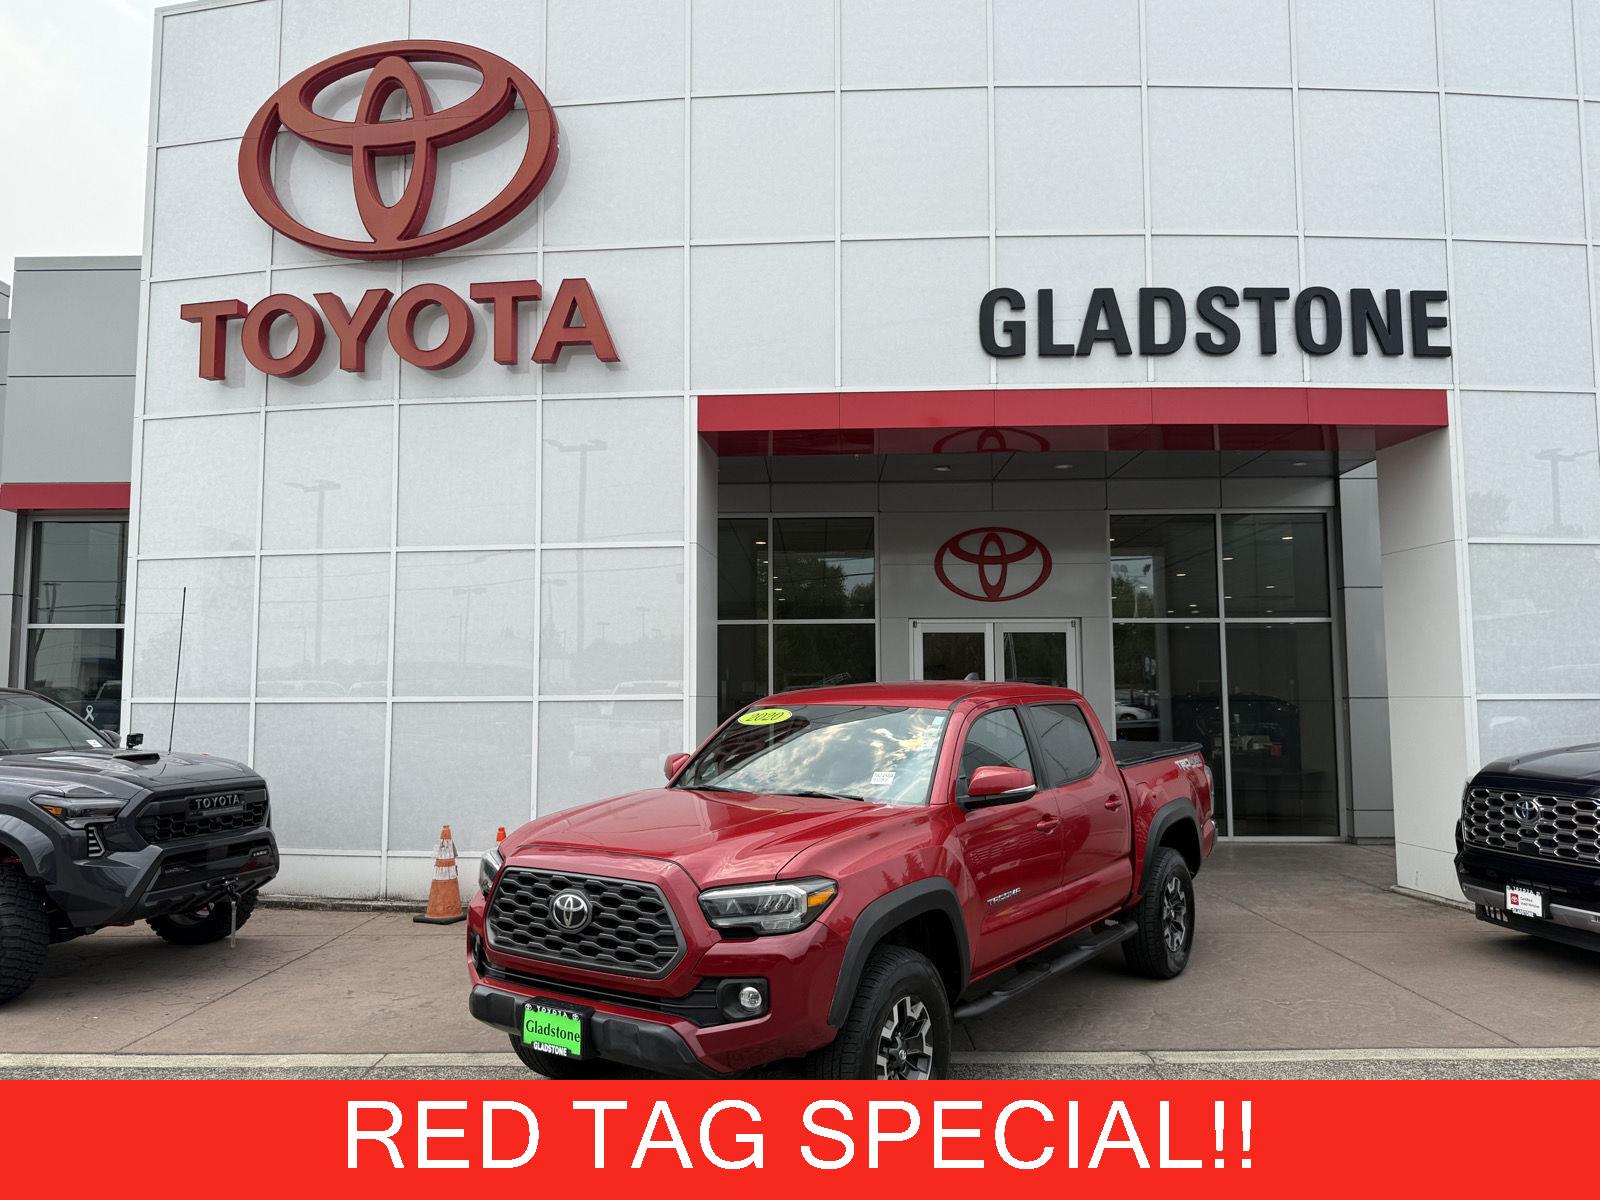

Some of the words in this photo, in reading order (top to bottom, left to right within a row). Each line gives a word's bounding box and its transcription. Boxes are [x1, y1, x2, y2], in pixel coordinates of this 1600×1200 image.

[181, 278, 620, 380] TOYOTA
[979, 286, 1452, 359] GLADSTONE
[744, 711, 785, 722] 2020
[195, 794, 241, 809] TOYOTA
[536, 1005, 567, 1017] TOYOTA
[526, 1020, 580, 1042] Gladstone
[533, 1041, 567, 1056] GLADSTONE
